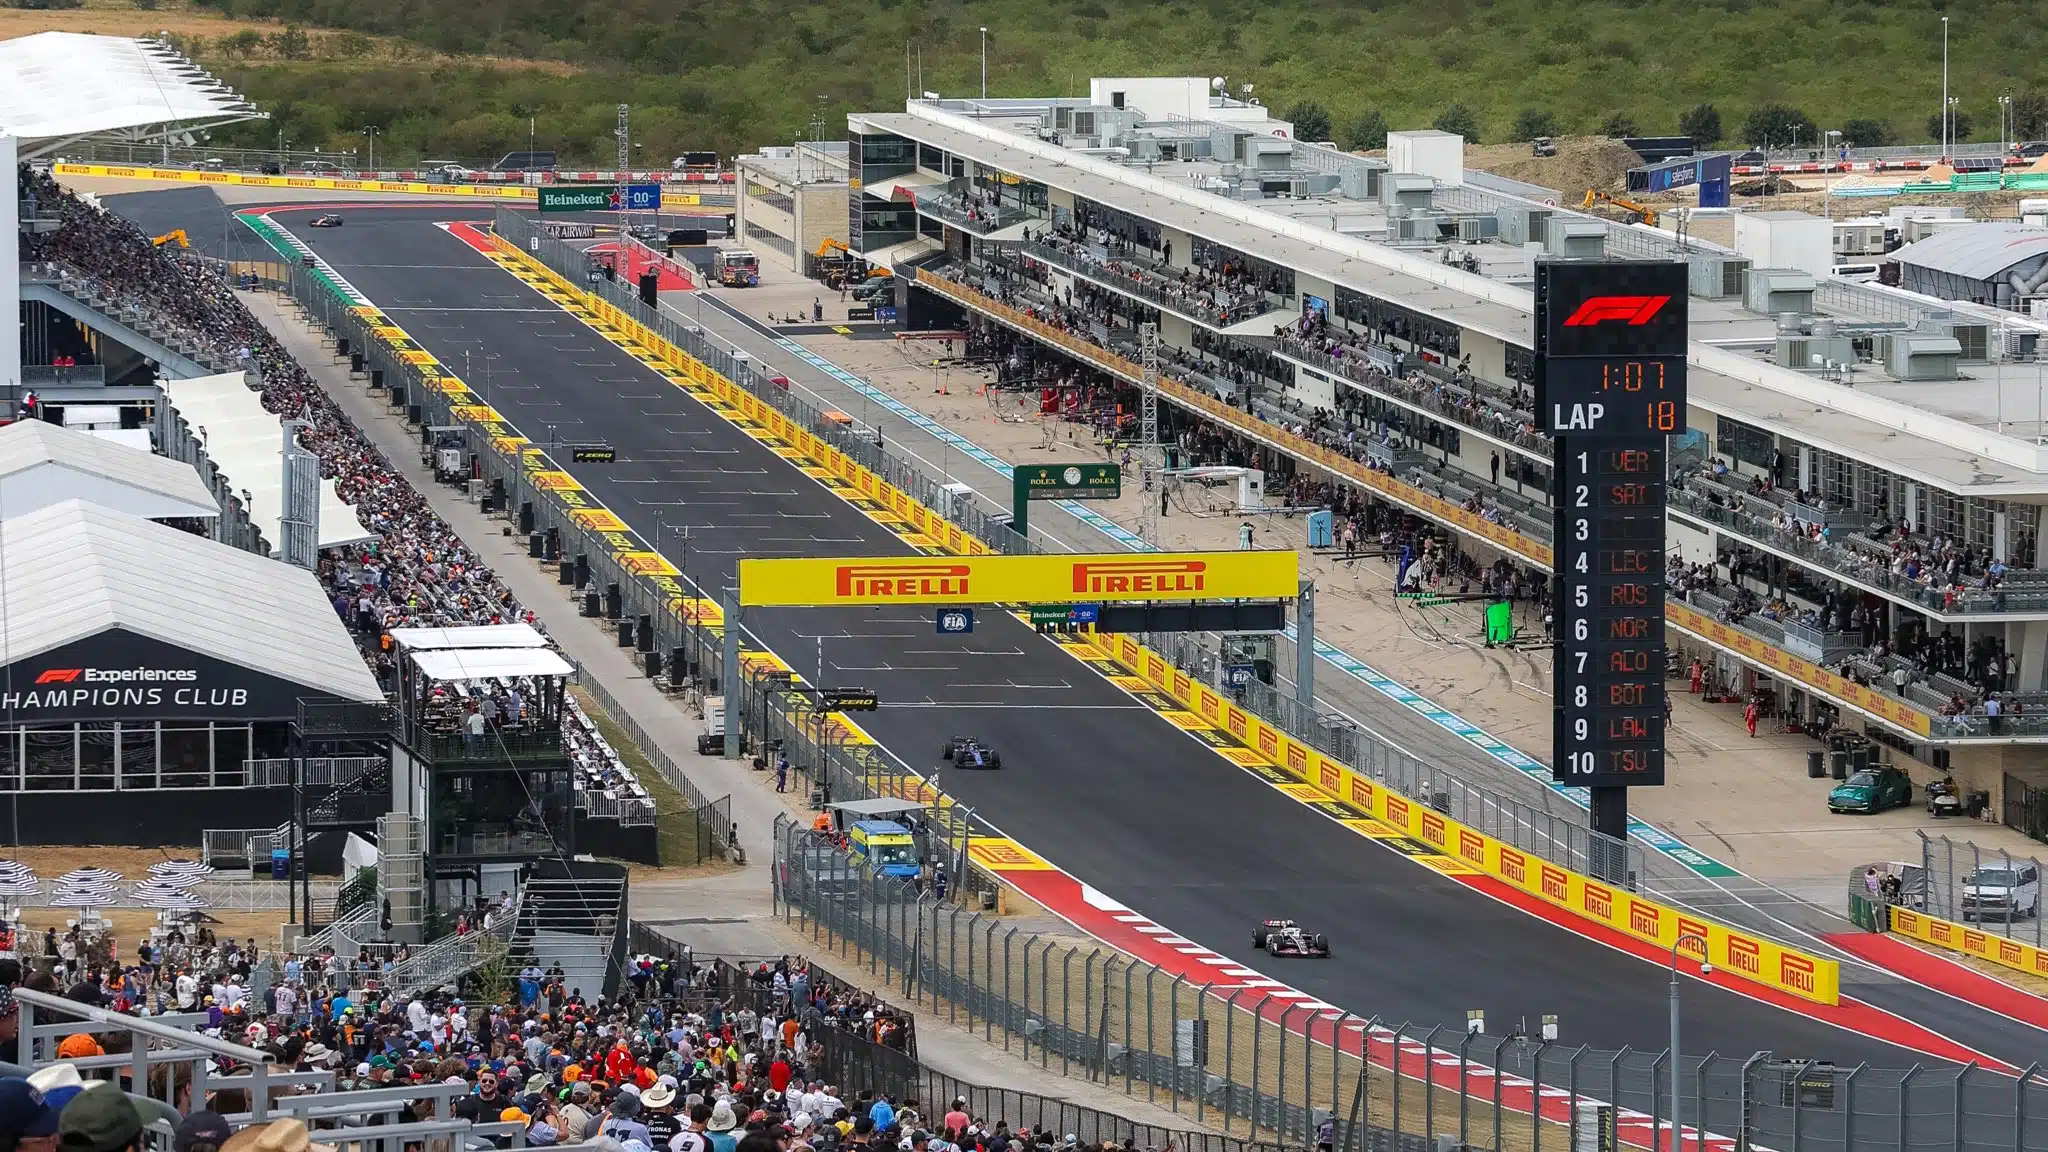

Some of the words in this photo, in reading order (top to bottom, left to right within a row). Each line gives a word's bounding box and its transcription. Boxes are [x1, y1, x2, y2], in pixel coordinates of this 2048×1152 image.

[1672, 166, 1694, 184] salesforce
[544, 193, 604, 206] Heineken
[634, 192, 648, 204] 0.0
[561, 226, 593, 238] AIRWAYS
[1604, 362, 1664, 392] 1:07
[1554, 403, 1605, 430] LAP
[1648, 401, 1676, 430] 18
[1577, 452, 1588, 474] 1
[1612, 452, 1648, 472] VER
[1576, 485, 1589, 507] 2
[1612, 484, 1647, 505] SAI
[1576, 518, 1588, 540] 3
[1575, 552, 1588, 574] 4
[1612, 552, 1648, 572] LEC
[836, 564, 971, 596] PIRELLI
[1072, 561, 1206, 592] PIRELLI
[1575, 585, 1588, 608] 5
[1611, 584, 1648, 606] RUS
[944, 616, 966, 628] FIA
[1033, 611, 1066, 619] Heineken
[1575, 618, 1588, 641] 6
[1610, 619, 1648, 638] NOR
[84, 666, 198, 684] Experiences
[1574, 652, 1588, 674] 7
[1610, 652, 1648, 672] ALO
[174, 688, 248, 706] CLUB
[1201, 690, 1219, 722] PIRELLI
[1575, 685, 1588, 708] 8
[1610, 685, 1646, 705] BOT
[1228, 706, 1247, 740] PIRELLI
[1575, 718, 1588, 740] 9
[1610, 718, 1648, 738] LAW
[1259, 724, 1278, 758] PIRELLI
[1288, 742, 1307, 776] PIRELLI
[1568, 751, 1595, 774] 10
[1610, 751, 1647, 772] TSU
[1320, 760, 1340, 794] PIRELLI
[1352, 776, 1373, 812] PIRELLI
[1386, 794, 1409, 830] PIRELLI
[1422, 812, 1445, 847] PIRELLI
[1460, 830, 1484, 866] PIRELLI
[1500, 847, 1526, 885] PIRELLI
[1542, 864, 1568, 902] PIRELLI
[1584, 882, 1612, 921] PIRELLI
[1630, 900, 1660, 939] PIRELLI
[1898, 910, 1918, 934] PIRELLI
[1930, 920, 1952, 944] PIRELLI
[1964, 930, 1986, 954] PIRELLI
[1728, 934, 1760, 975] PIRELLI
[2000, 940, 2022, 965] PIRELLI
[1781, 952, 1814, 994] PIRELLI
